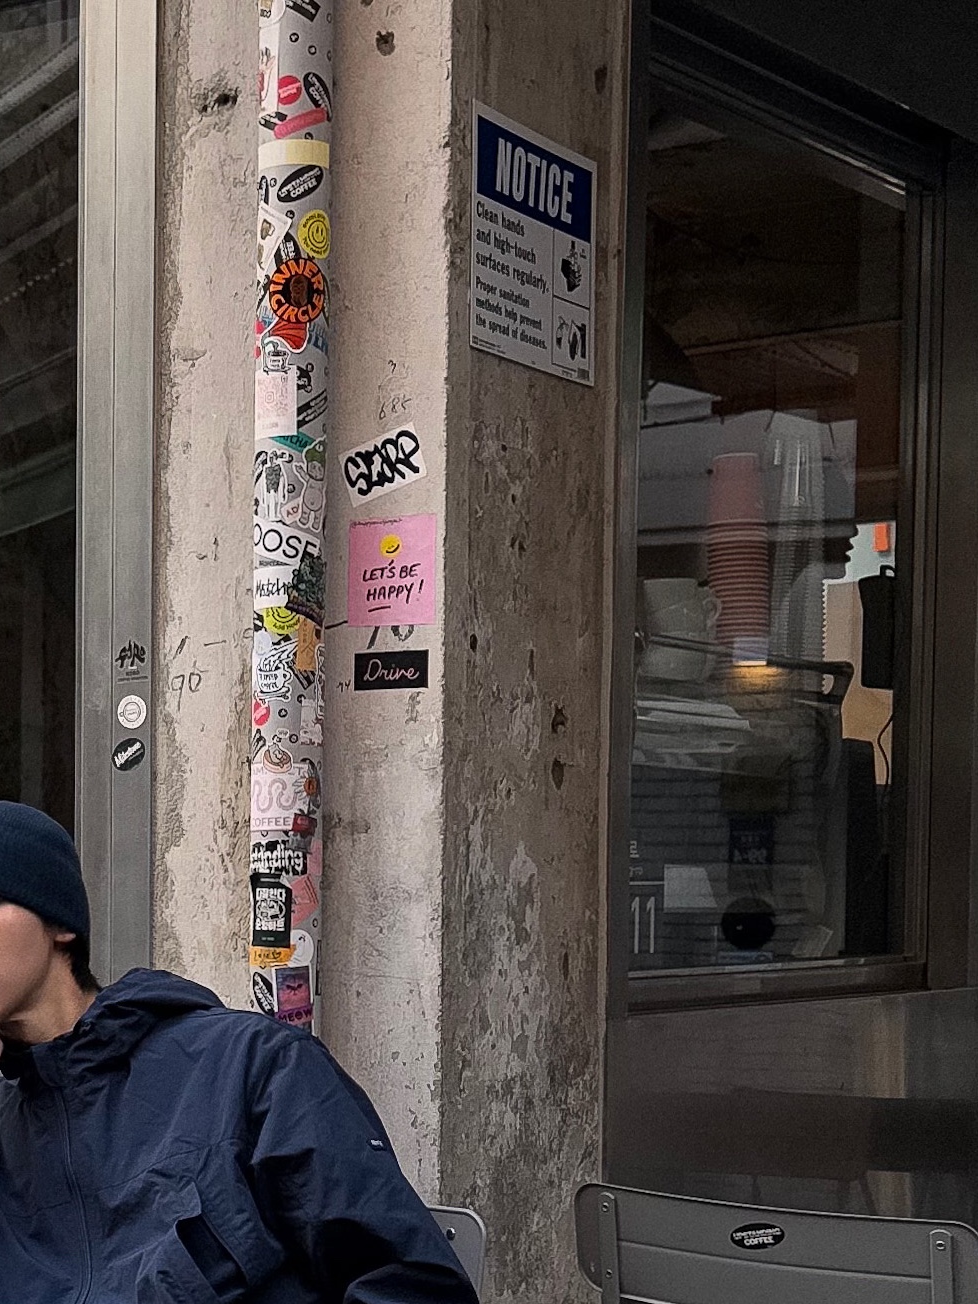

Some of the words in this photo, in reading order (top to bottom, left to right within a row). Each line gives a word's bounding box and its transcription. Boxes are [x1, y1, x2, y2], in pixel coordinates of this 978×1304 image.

[290, 178, 318, 199] COFFEE
[495, 137, 574, 224] NOTICE
[476, 200, 499, 226] Clean
[501, 211, 525, 237] hands
[476, 228, 491, 245] and
[493, 231, 536, 265] high-touch
[269, 259, 324, 292] INNER
[475, 251, 510, 277] surfaces
[512, 266, 549, 294] regularly.
[270, 293, 324, 323] CIRCLE
[475, 276, 497, 296] Proper
[499, 287, 530, 309] sanitation
[475, 297, 503, 317] methods
[504, 304, 518, 323] help
[519, 314, 542, 331] prevent
[475, 313, 487, 328] the
[488, 319, 510, 336] spread
[511, 326, 519, 340] of
[519, 327, 548, 350] diseases.
[362, 559, 397, 582] LET'S
[399, 562, 422, 579] BE
[363, 658, 420, 682] Drive
[252, 816, 291, 828] OFFEE
[277, 1008, 313, 1023] MEOW
